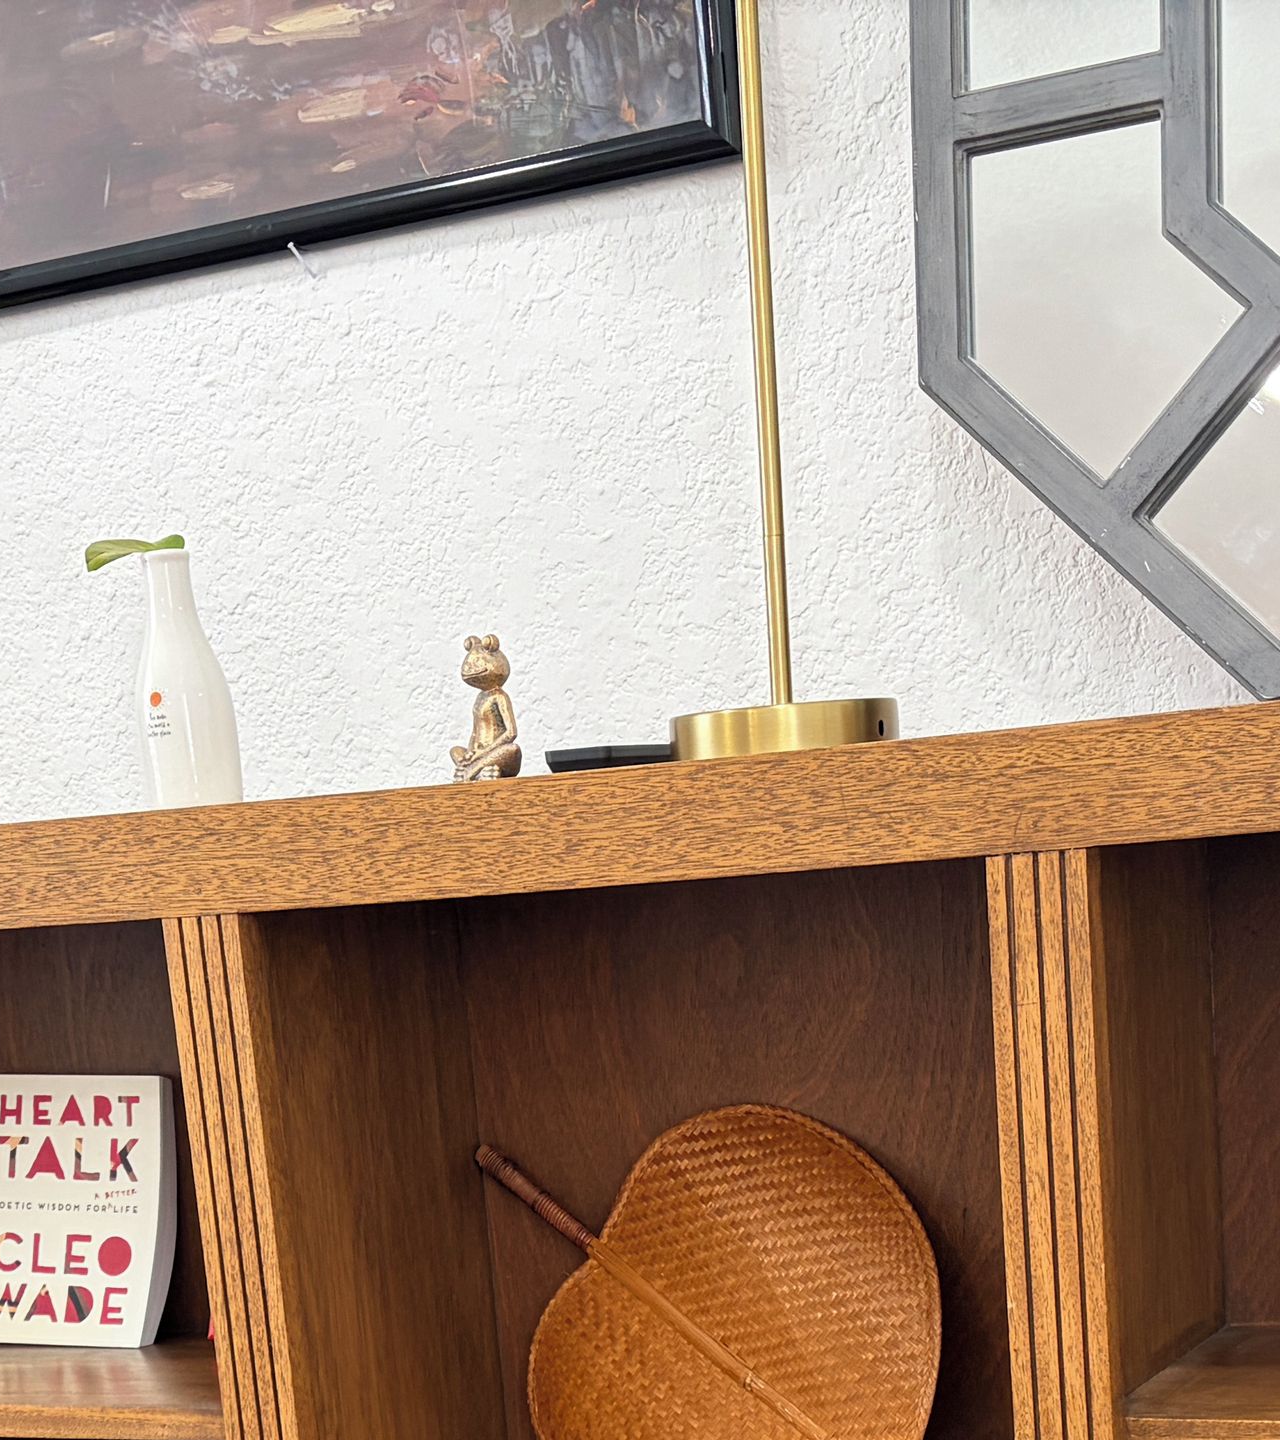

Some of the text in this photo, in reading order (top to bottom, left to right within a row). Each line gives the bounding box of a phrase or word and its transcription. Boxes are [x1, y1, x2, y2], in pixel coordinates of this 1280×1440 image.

[0, 1094, 140, 1127] HEART
[105, 1188, 137, 1199] BETTER
[38, 1203, 80, 1212] WISDOM
[87, 1204, 107, 1212] FOR
[113, 1205, 139, 1214] LIFE
